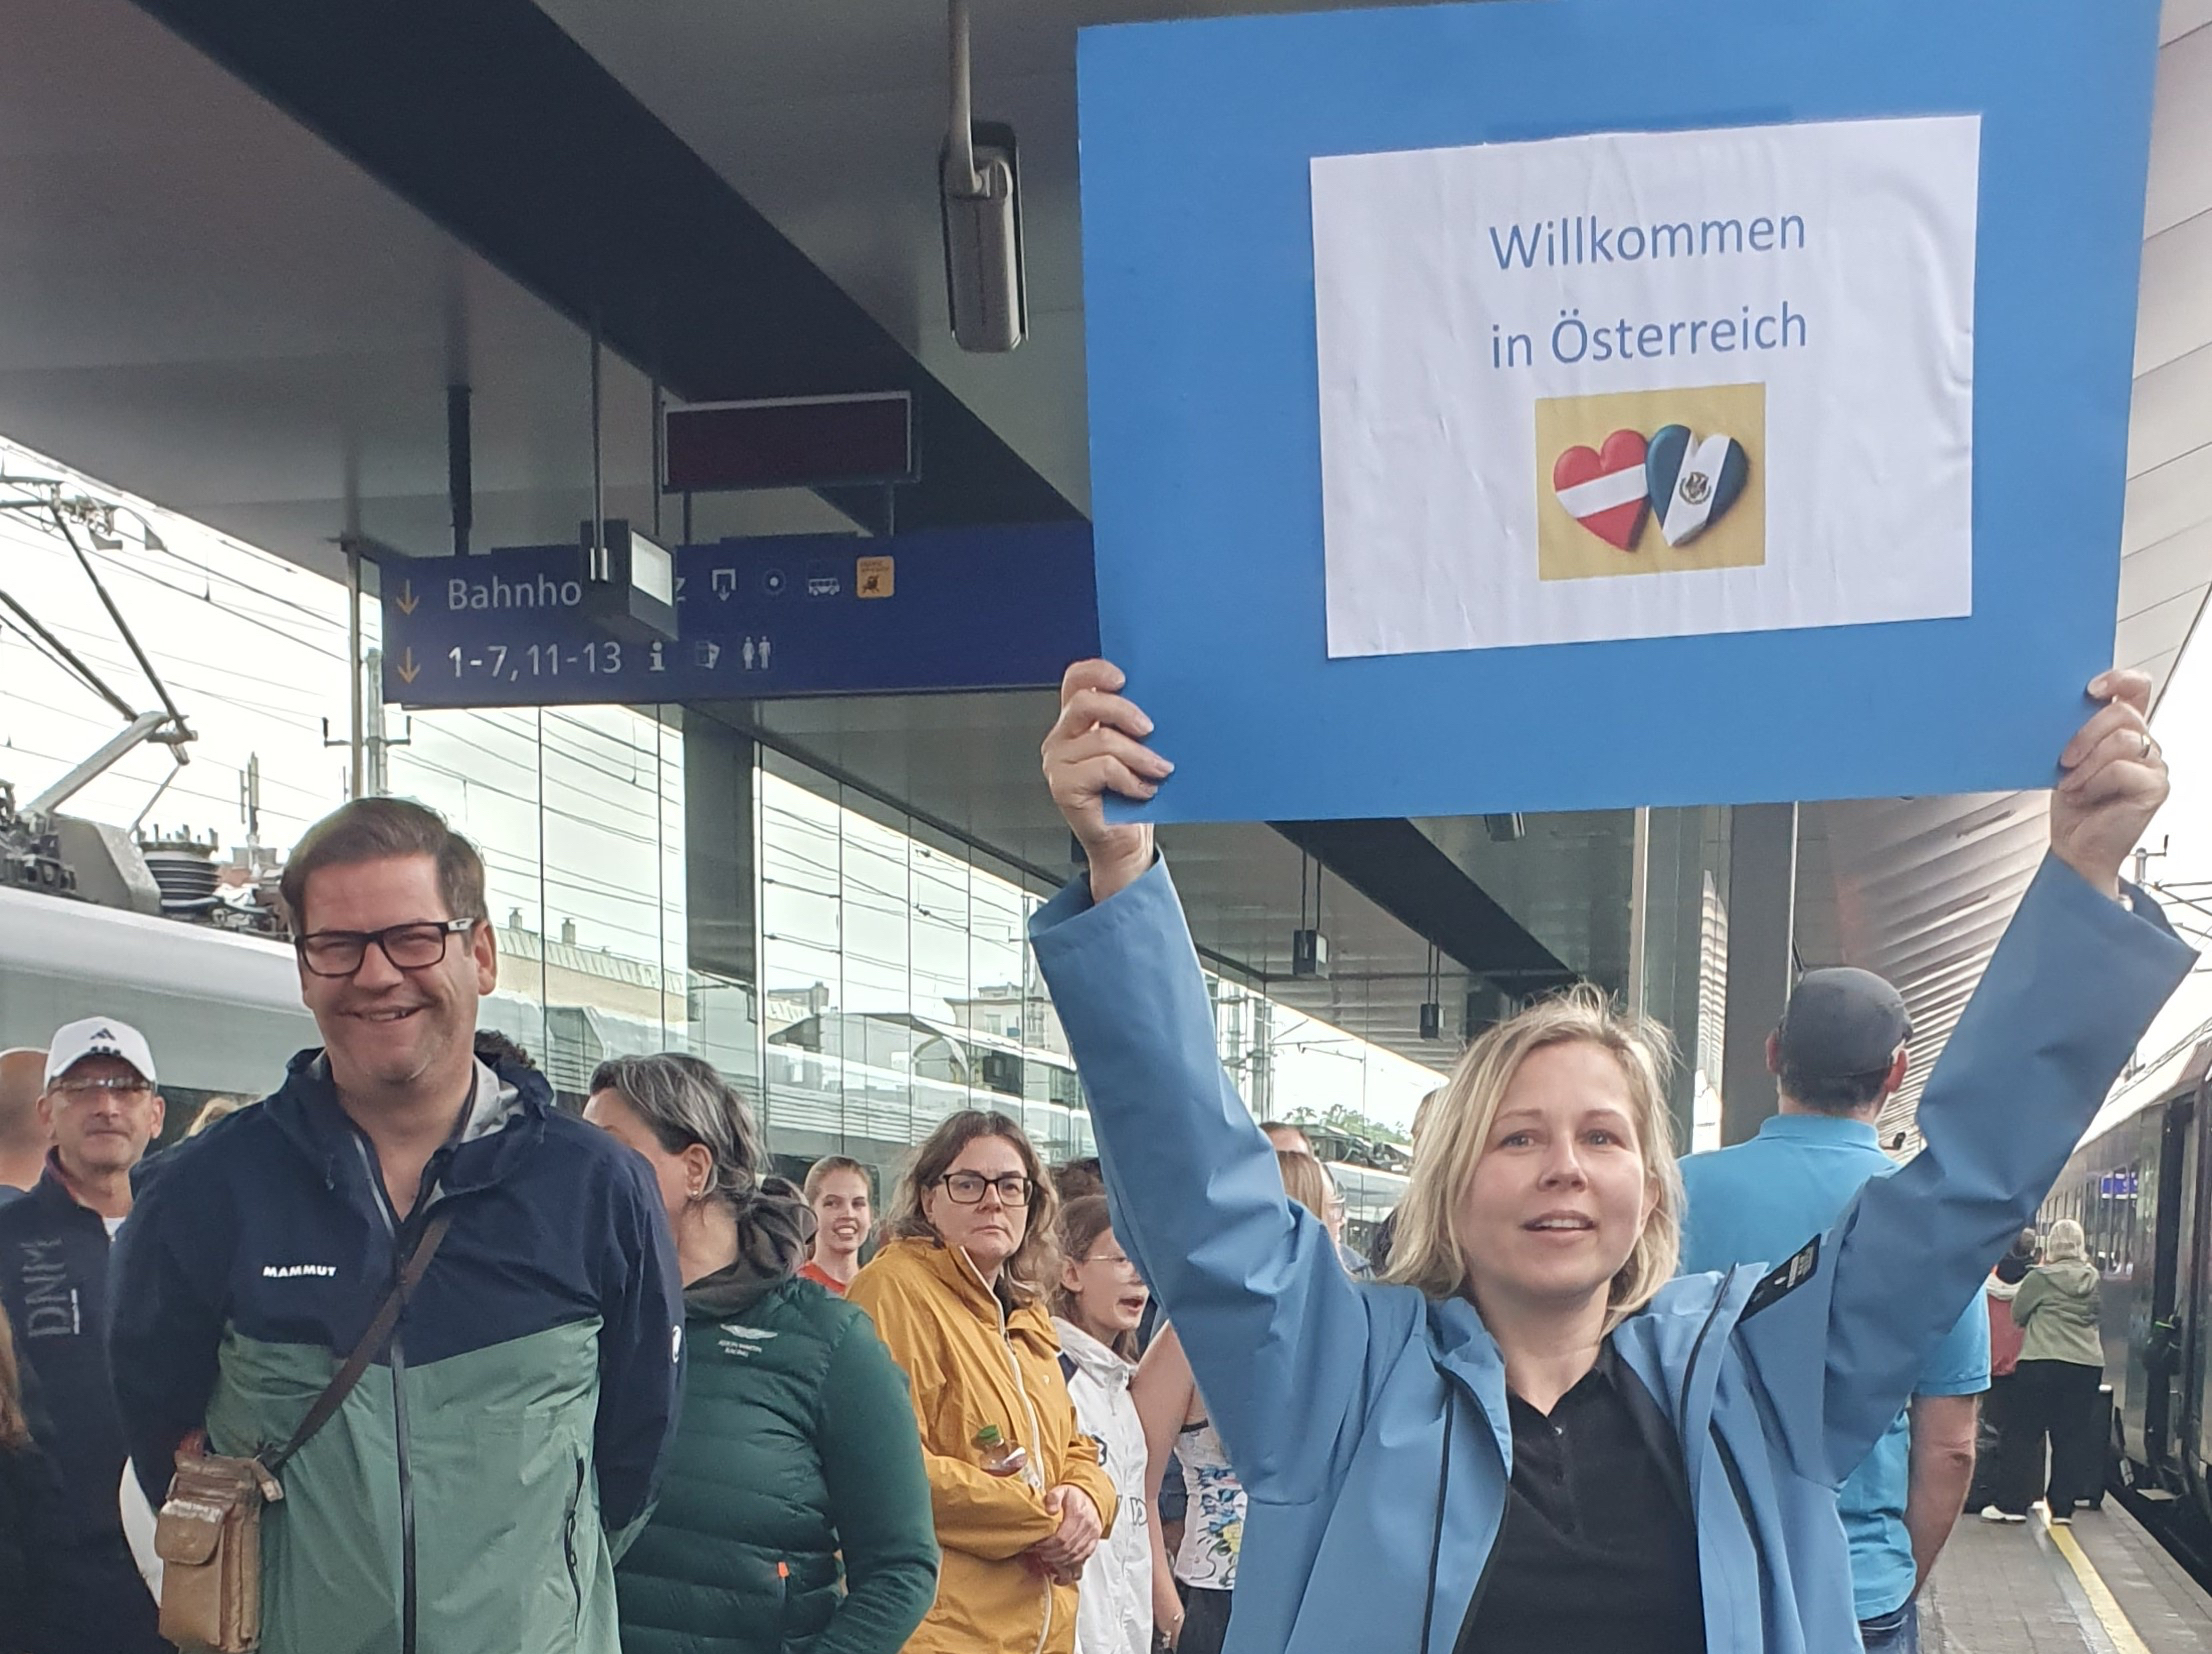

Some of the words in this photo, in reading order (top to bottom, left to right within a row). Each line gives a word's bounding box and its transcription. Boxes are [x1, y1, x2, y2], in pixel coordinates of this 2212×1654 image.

[1489, 214, 1805, 270] Willkommen
[1492, 323, 1533, 368] in
[1551, 300, 1807, 364] Österreich
[262, 1264, 337, 1278] MAMMUT
